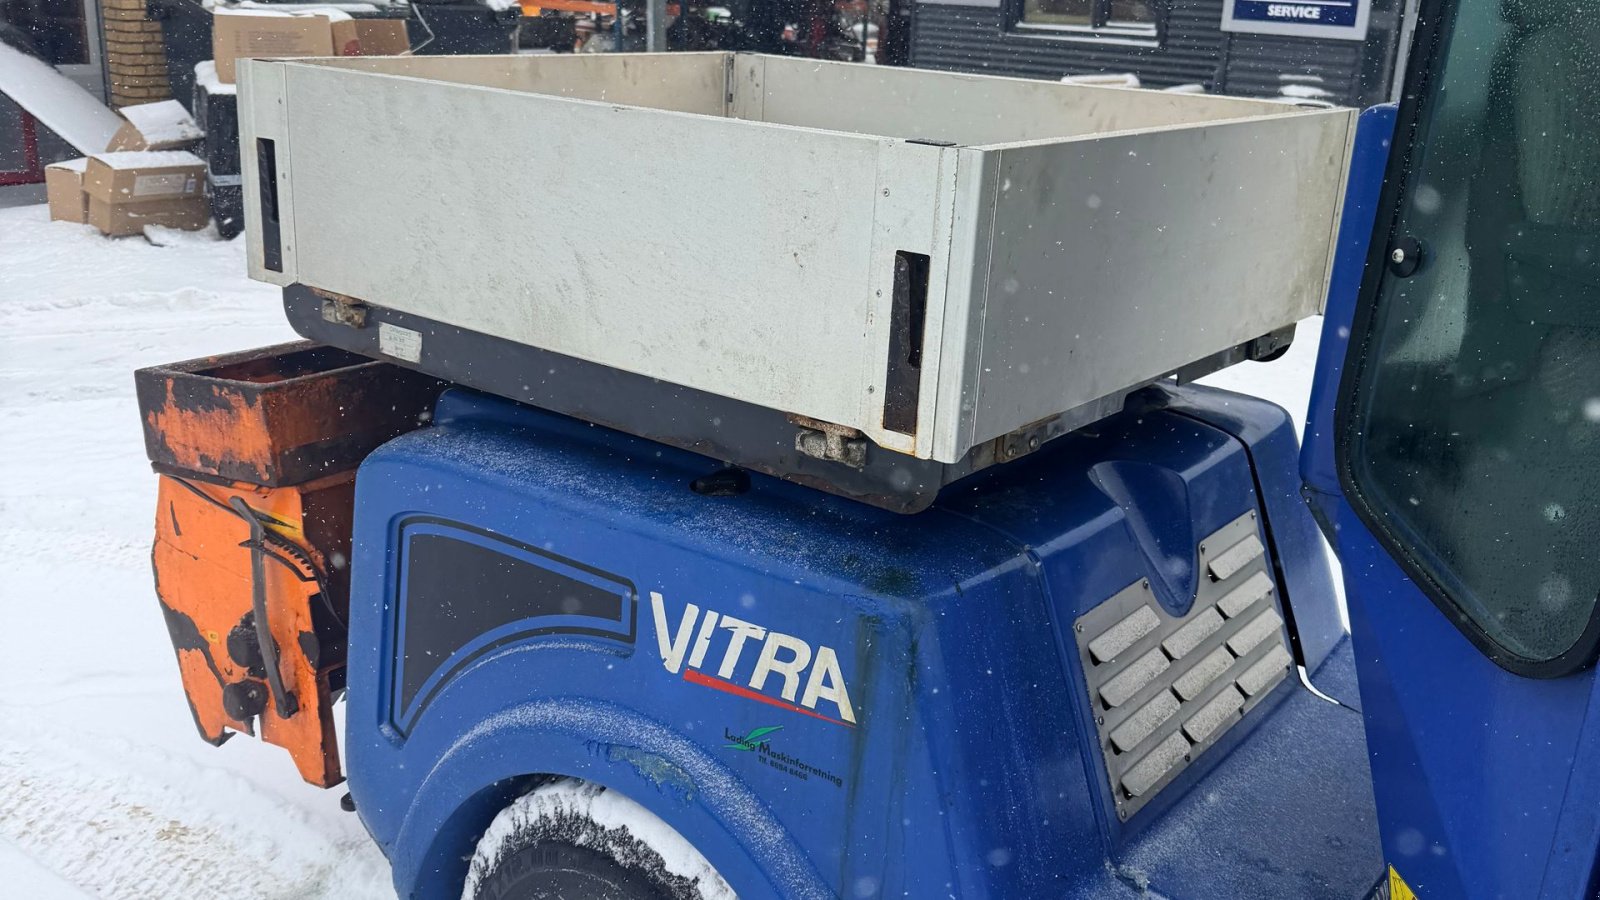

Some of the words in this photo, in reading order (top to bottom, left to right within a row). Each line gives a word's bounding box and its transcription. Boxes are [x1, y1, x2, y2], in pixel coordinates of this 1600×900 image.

[1267, 4, 1321, 19] SERVICE
[650, 591, 857, 724] VITRA
[724, 727, 756, 752] Lading
[758, 741, 843, 788] Maskinforretning
